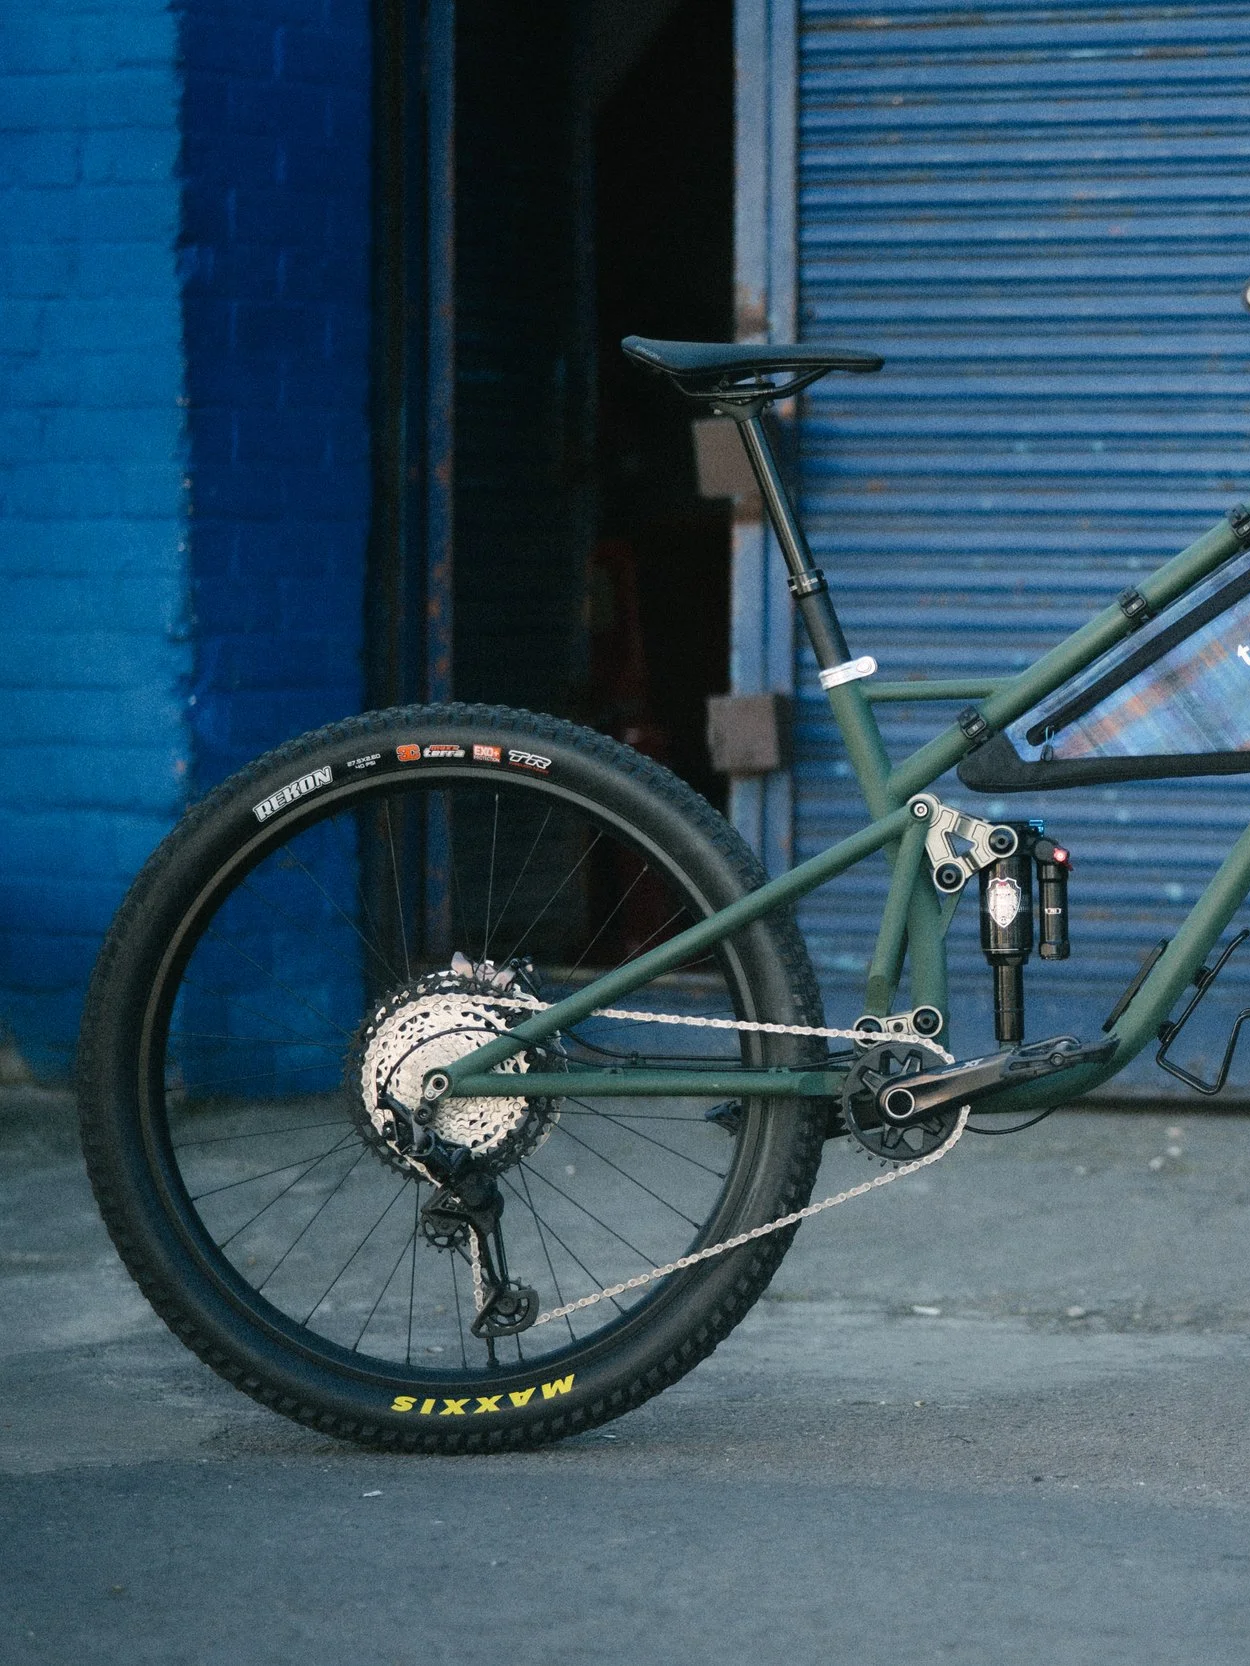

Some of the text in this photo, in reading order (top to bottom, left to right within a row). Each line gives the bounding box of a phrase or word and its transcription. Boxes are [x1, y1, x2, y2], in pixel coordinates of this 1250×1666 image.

[396, 743, 421, 762] 3C
[474, 745, 500, 757] EXO+
[508, 749, 552, 770] TR
[252, 765, 334, 823] REKON
[390, 1373, 576, 1416] MAXXIS
